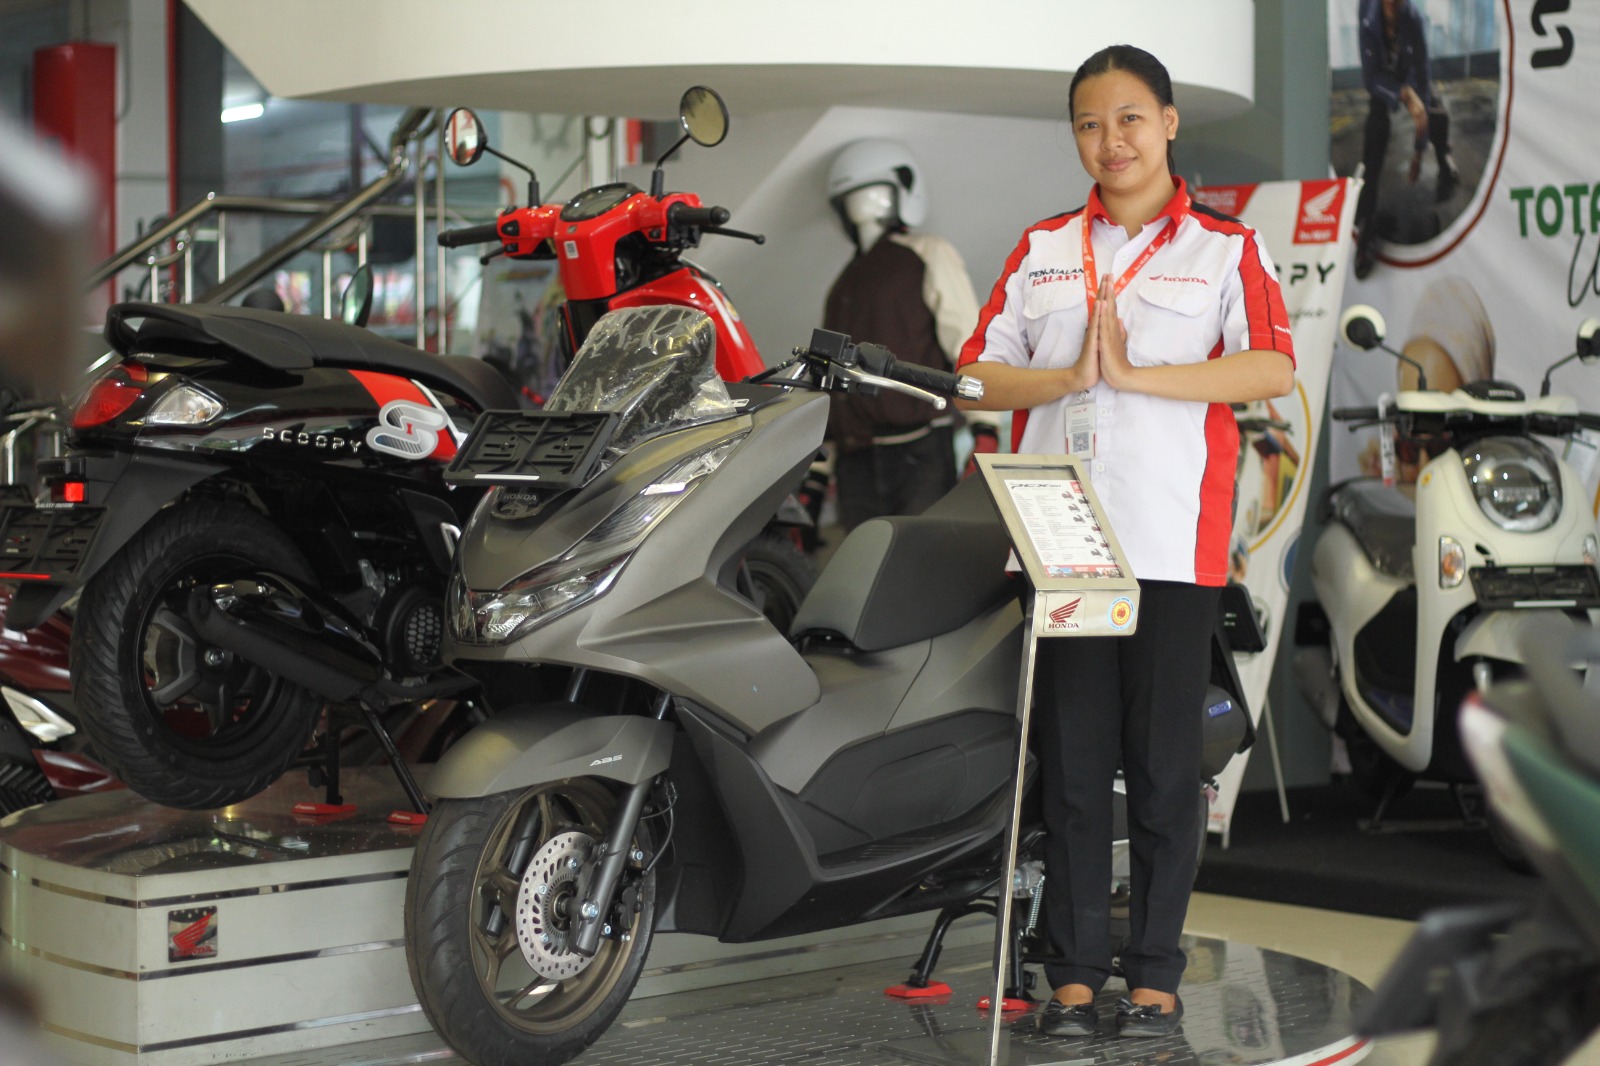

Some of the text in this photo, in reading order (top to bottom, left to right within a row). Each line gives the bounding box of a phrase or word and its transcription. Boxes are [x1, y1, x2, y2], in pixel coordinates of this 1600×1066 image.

[1032, 274, 1081, 287] GALAXY
[1163, 276, 1208, 285] HONDA
[263, 427, 362, 453] SCOOPY
[503, 493, 537, 501] HONDA
[590, 754, 623, 767] ABS
